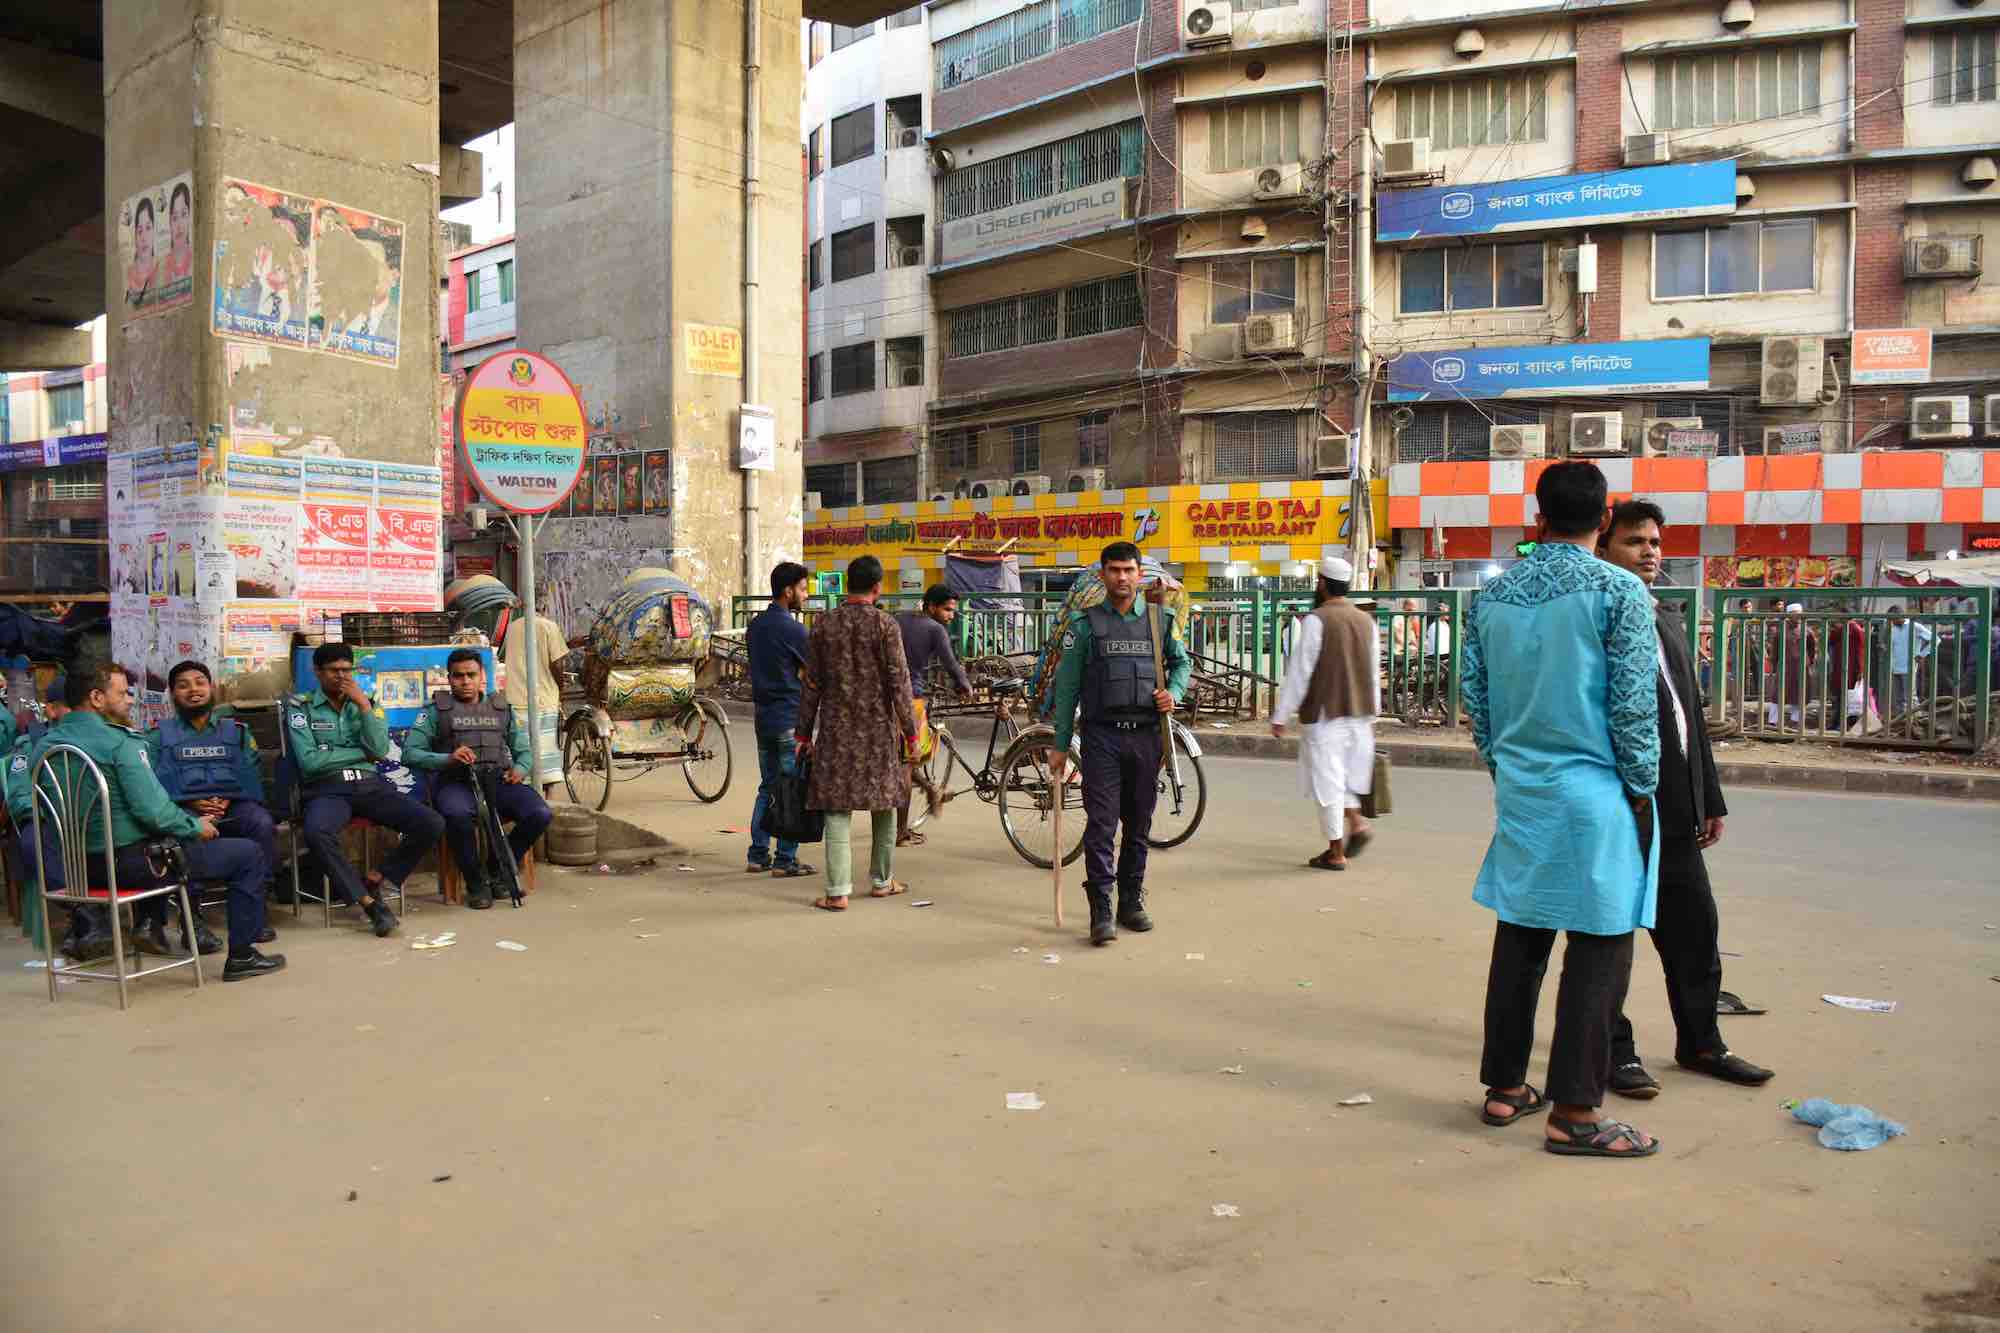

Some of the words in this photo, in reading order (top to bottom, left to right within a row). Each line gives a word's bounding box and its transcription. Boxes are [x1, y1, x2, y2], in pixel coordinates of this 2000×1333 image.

[1487, 194, 1529, 210] জনতা
[1535, 191, 1575, 207] ব্যাংক
[1580, 183, 1643, 202] লিমিটেড
[689, 328, 737, 351] TO-LET
[1479, 361, 1520, 376] জনতা
[1525, 359, 1566, 374] ব্যাংক
[1571, 354, 1633, 371] লিমিটেড
[504, 394, 543, 416] বাস
[469, 413, 537, 440] স্টপেজ
[544, 424, 577, 441] শুরু
[476, 447, 511, 463] ট্রাফিক
[545, 451, 576, 466] বিভাগ
[498, 475, 557, 489] WALTON
[1187, 500, 1251, 521] CAFE
[1256, 501, 1273, 520] D
[1279, 499, 1321, 519] TAJ
[1193, 521, 1316, 538] RESTAURANT
[1111, 641, 1147, 651] POLICE
[454, 716, 498, 727] POLICE
